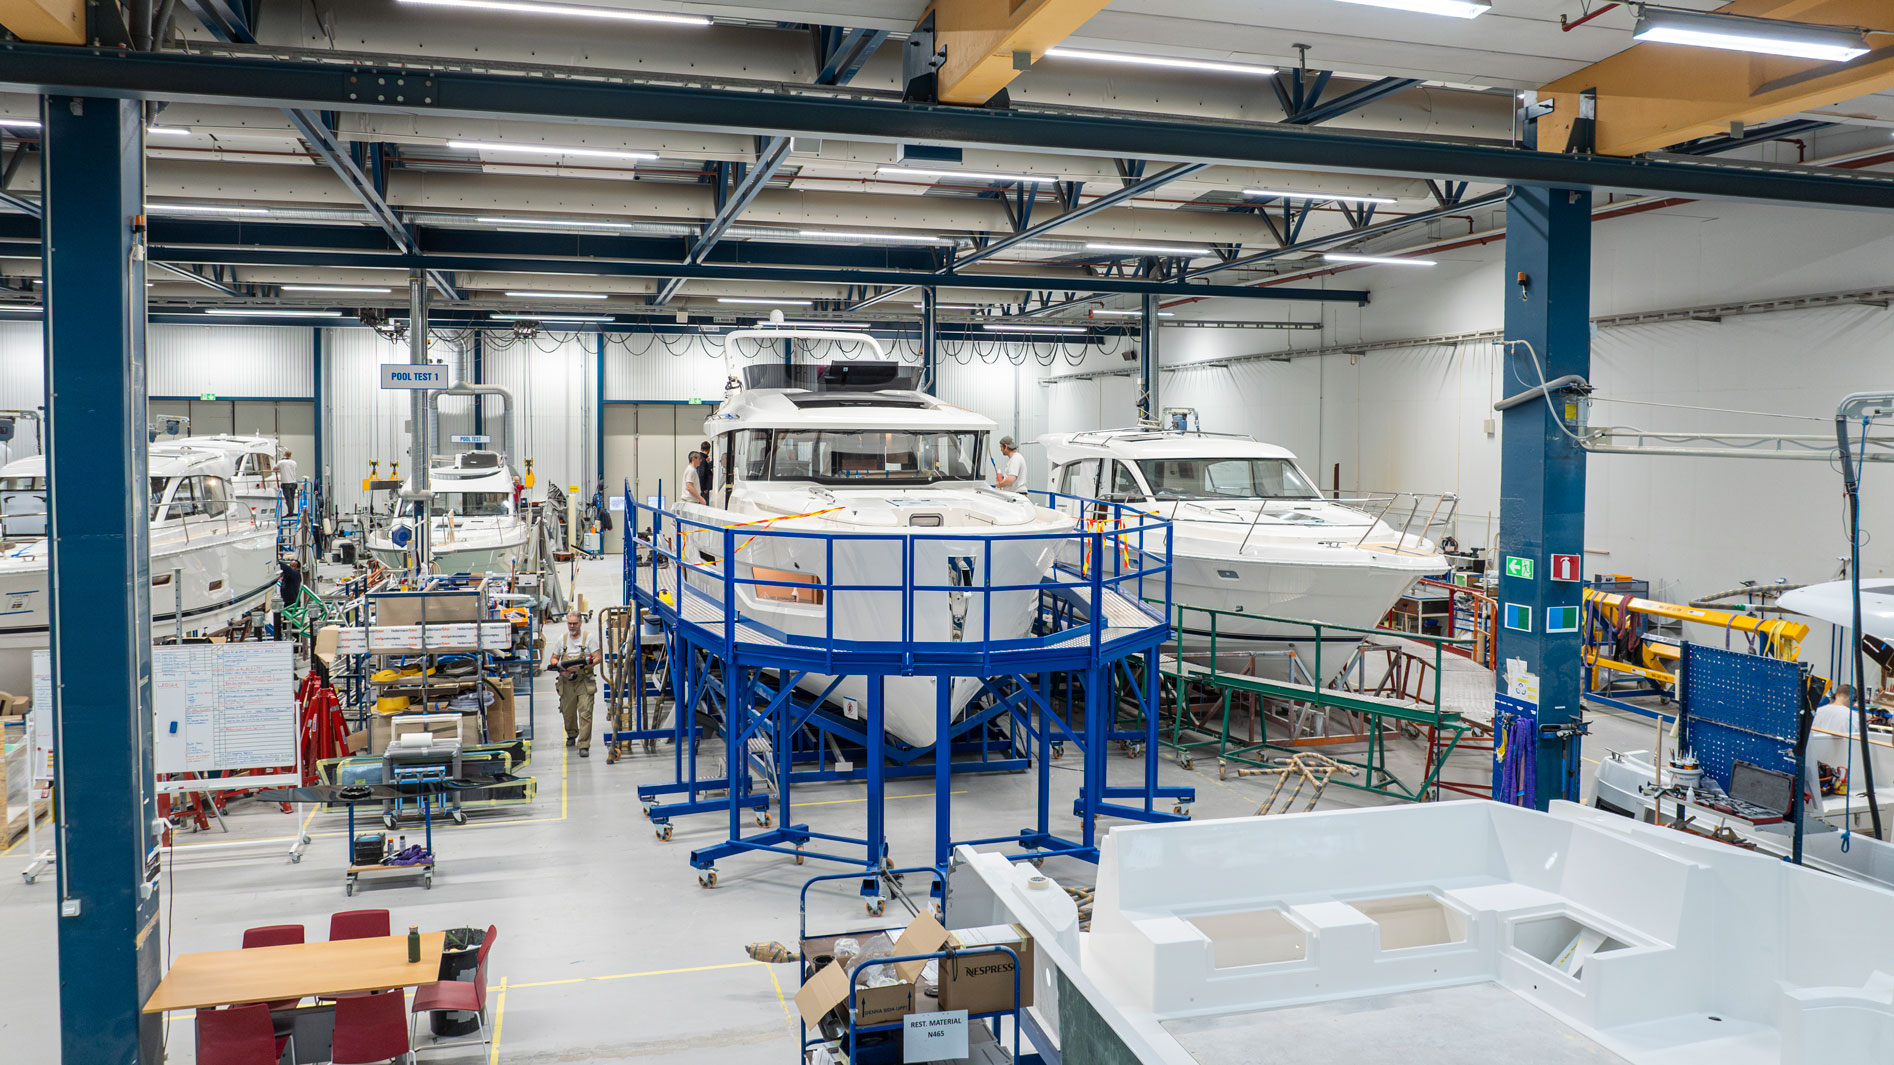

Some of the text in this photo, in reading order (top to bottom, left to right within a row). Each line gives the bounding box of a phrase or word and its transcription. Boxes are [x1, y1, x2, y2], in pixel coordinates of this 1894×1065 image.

[391, 372, 439, 381] POOL TEST 1
[964, 962, 1017, 977] NESPRESS
[910, 1017, 962, 1028] REST. MATERIAL
[927, 1030, 945, 1038] N465
